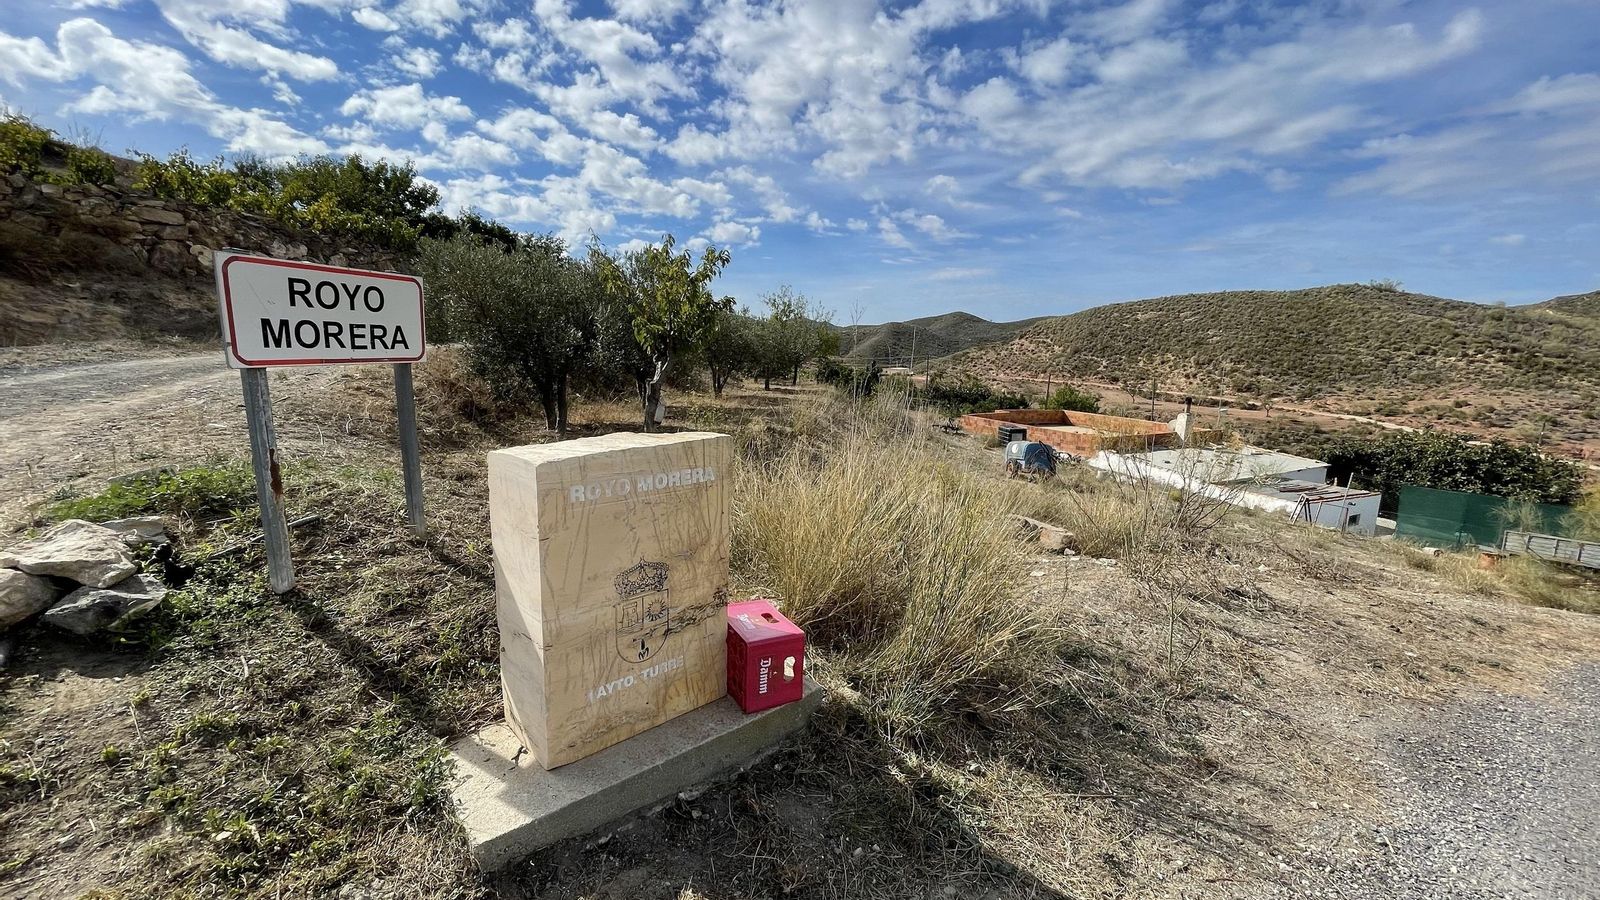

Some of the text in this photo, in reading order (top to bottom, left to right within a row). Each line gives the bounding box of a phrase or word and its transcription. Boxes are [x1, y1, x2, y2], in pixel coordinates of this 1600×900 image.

[287, 277, 385, 313] ROYO
[260, 317, 410, 350] MORERA
[569, 467, 715, 502] ROYO MORERA
[759, 657, 772, 694] Damm
